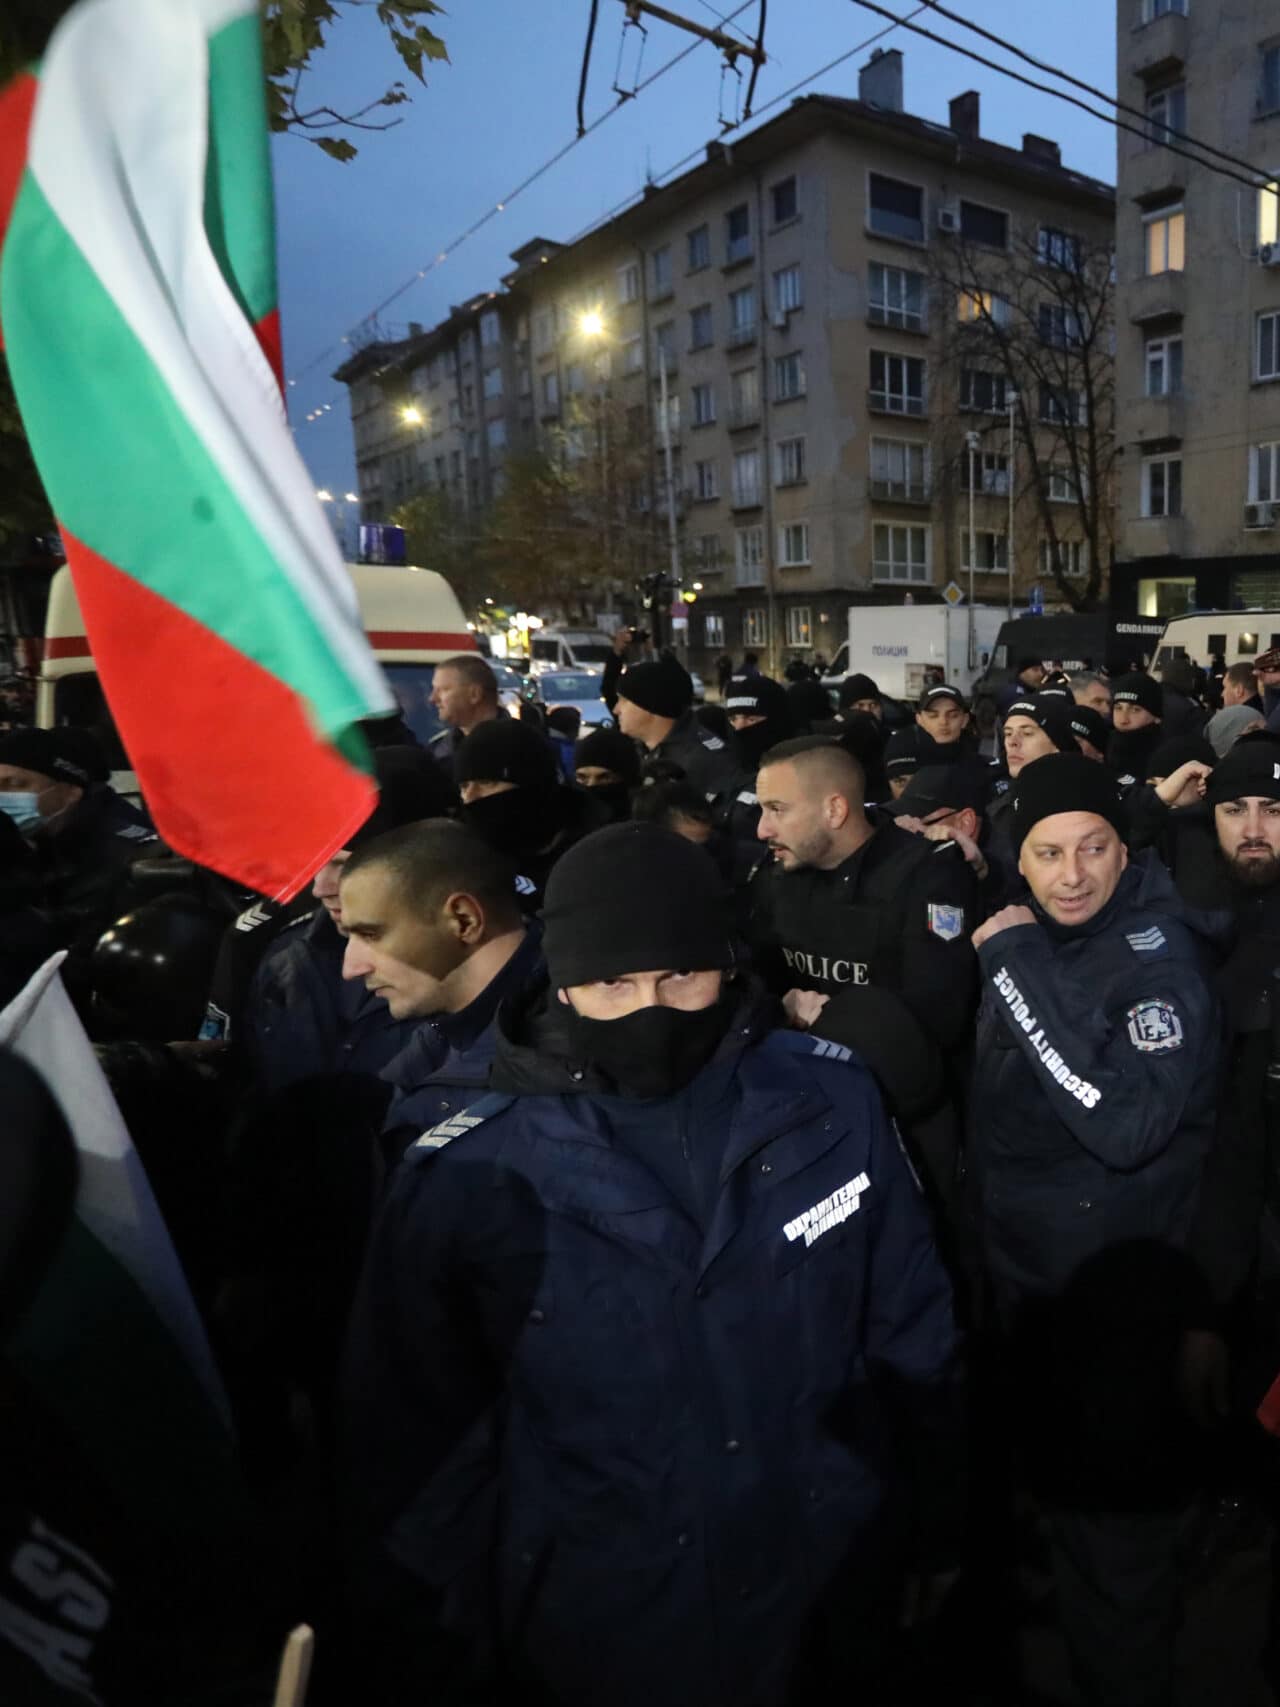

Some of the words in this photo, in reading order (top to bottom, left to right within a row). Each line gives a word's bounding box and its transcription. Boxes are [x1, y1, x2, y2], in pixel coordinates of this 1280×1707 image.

[871, 645, 908, 657] ПОЛИЦИЯ
[782, 947, 869, 985] POLICE
[992, 966, 1037, 1034] POLICE
[1028, 1028, 1102, 1109] SECURITY
[804, 1192, 861, 1249] ПОЛИЦИЯ
